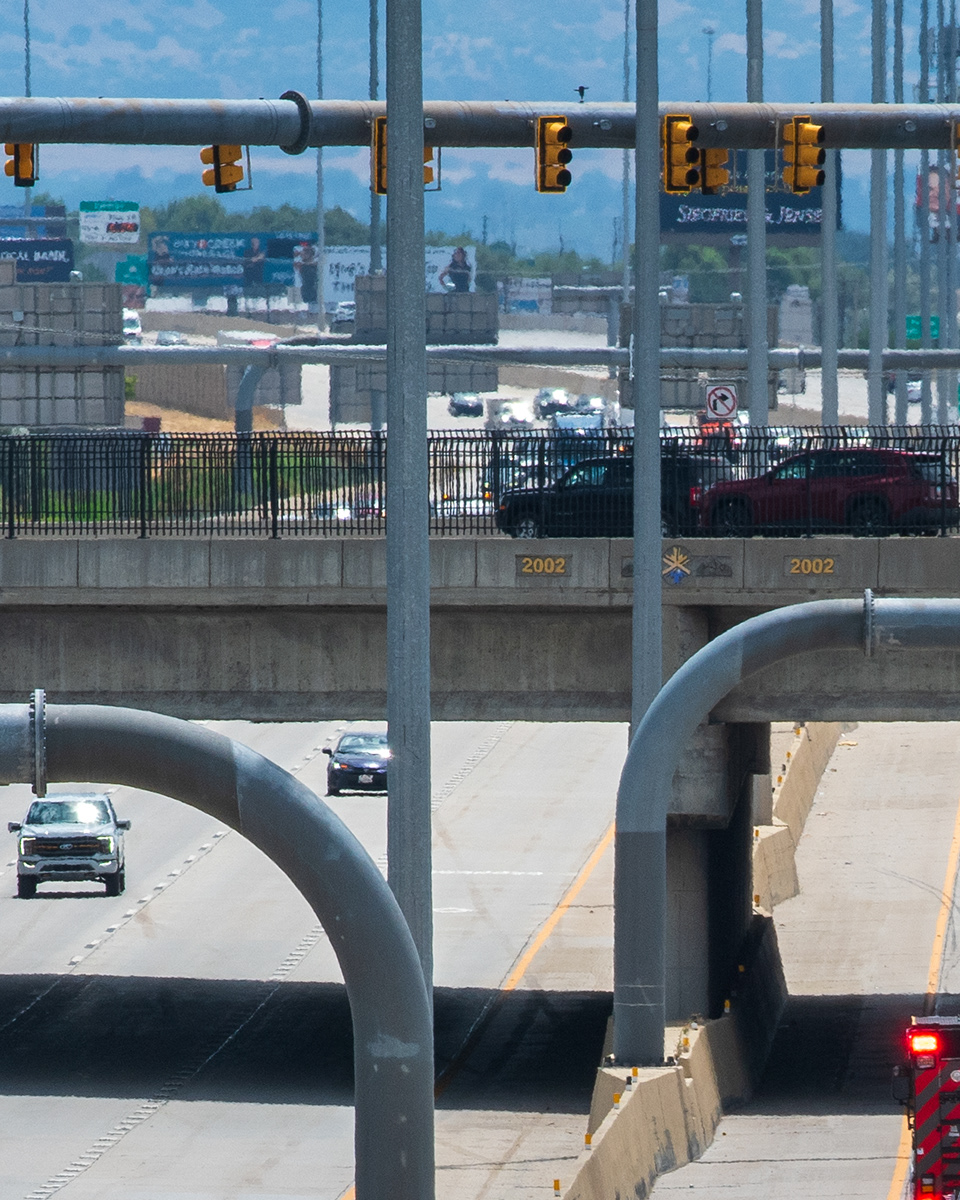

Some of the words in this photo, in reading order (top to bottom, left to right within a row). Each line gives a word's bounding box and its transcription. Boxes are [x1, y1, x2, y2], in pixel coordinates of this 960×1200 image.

[677, 204, 749, 223] SIEGFRIE
[776, 205, 823, 224] JENSE
[521, 557, 566, 574] 2002
[790, 558, 834, 574] 2002
